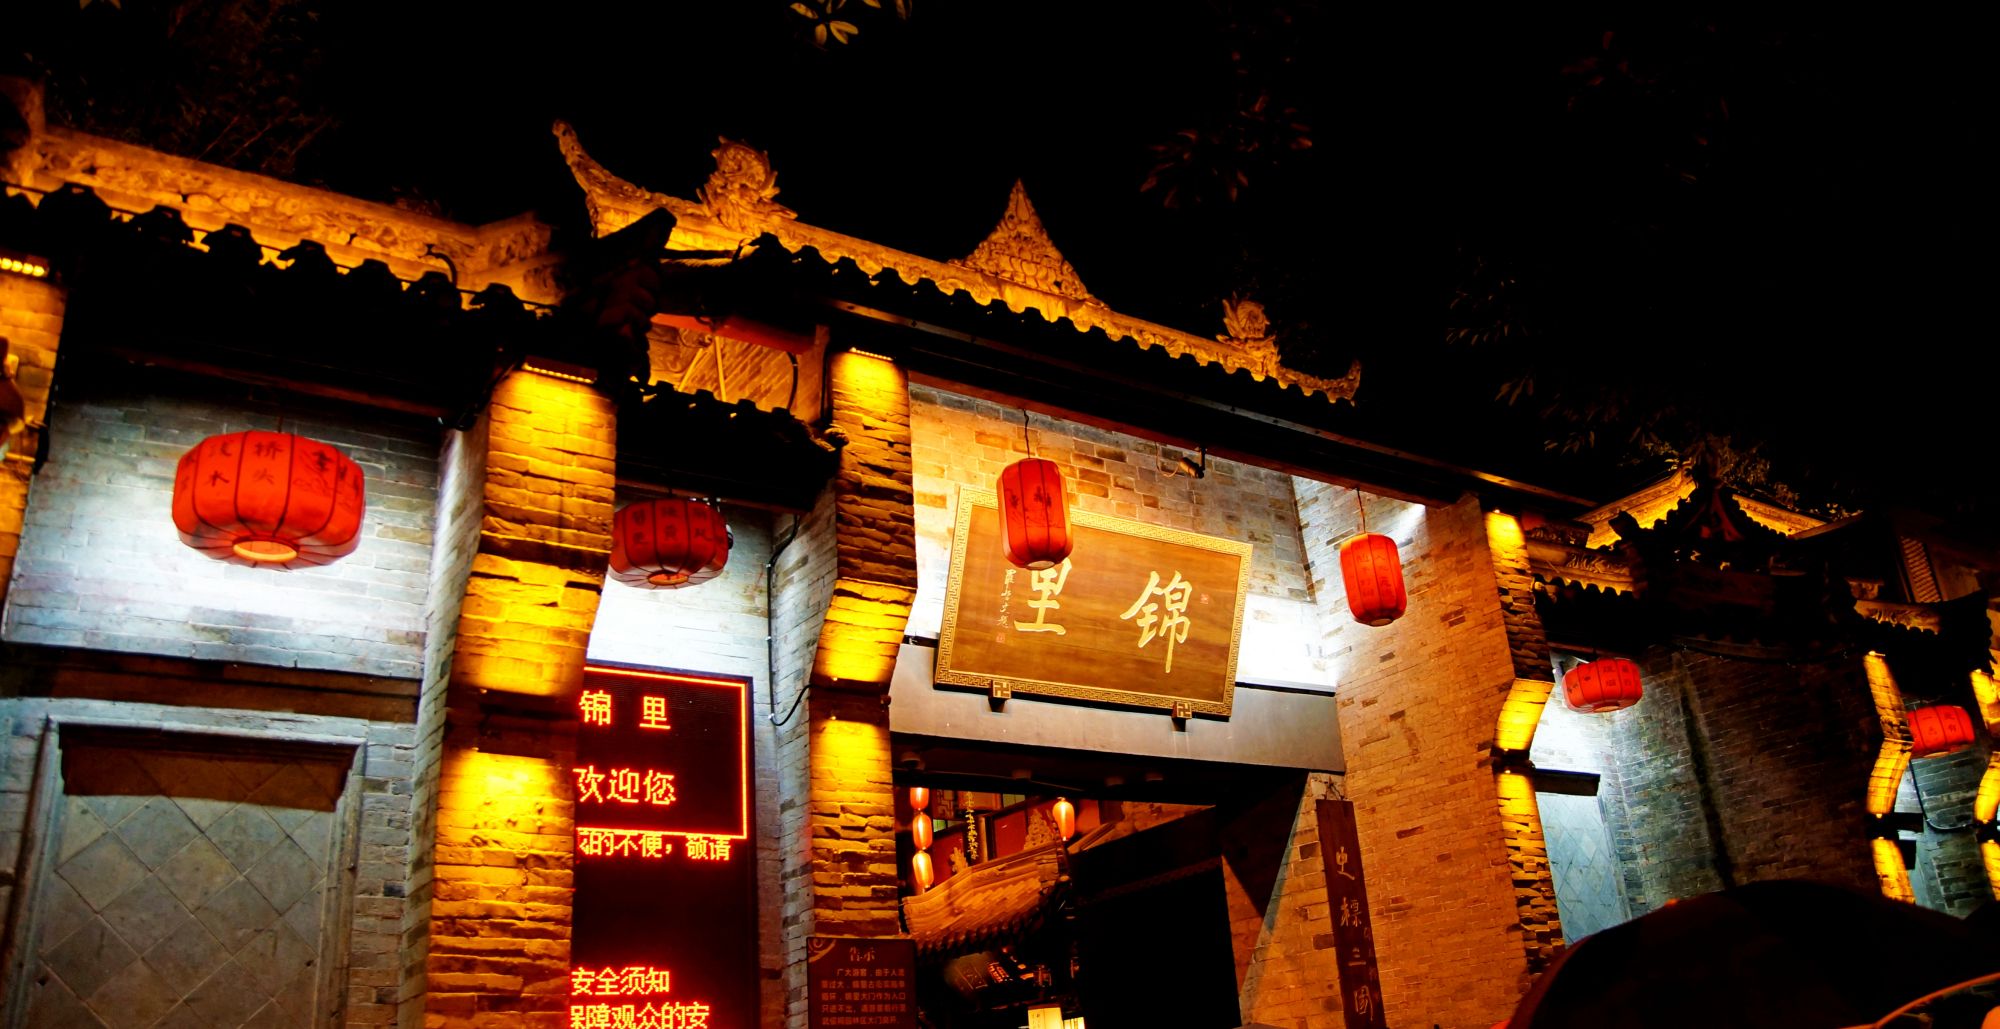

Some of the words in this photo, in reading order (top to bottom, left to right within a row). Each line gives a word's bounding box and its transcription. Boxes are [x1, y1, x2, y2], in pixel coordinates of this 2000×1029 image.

[578, 689, 671, 730] 锦里
[572, 765, 676, 805] 欢迎您
[570, 966, 670, 997] 安全须知
